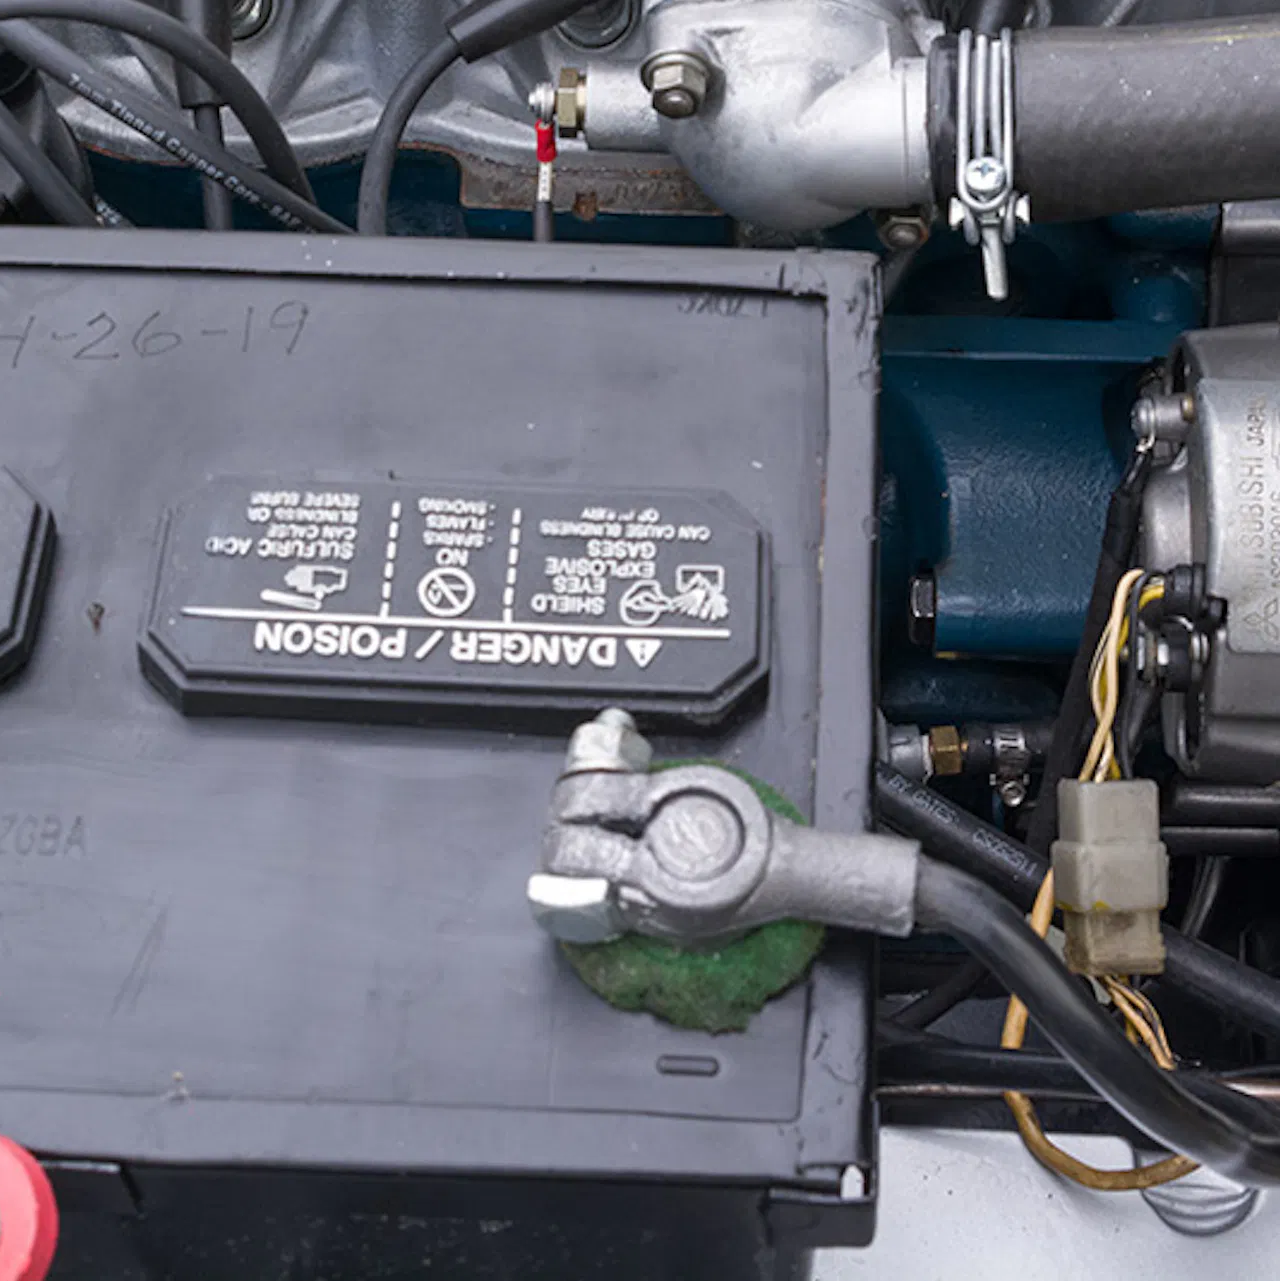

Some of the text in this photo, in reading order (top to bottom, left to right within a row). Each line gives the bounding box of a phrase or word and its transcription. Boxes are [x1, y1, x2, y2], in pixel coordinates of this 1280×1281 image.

[110, 99, 167, 143] Tinned
[418, 497, 488, 514] SMOKING
[267, 523, 357, 540] CAN CAUSE
[426, 514, 486, 530] FLAMES
[540, 520, 710, 541] CAN CAUSE BLINDNESS
[205, 536, 355, 560] SULFURIC ACID
[423, 530, 485, 547] SPARKS
[436, 548, 469, 566] NO
[587, 539, 656, 559] GASES
[545, 557, 656, 578] EXPLOSIVE
[552, 575, 606, 594] EYES
[530, 594, 605, 615] SHIELD
[254, 621, 617, 667] DANGER / POISON
